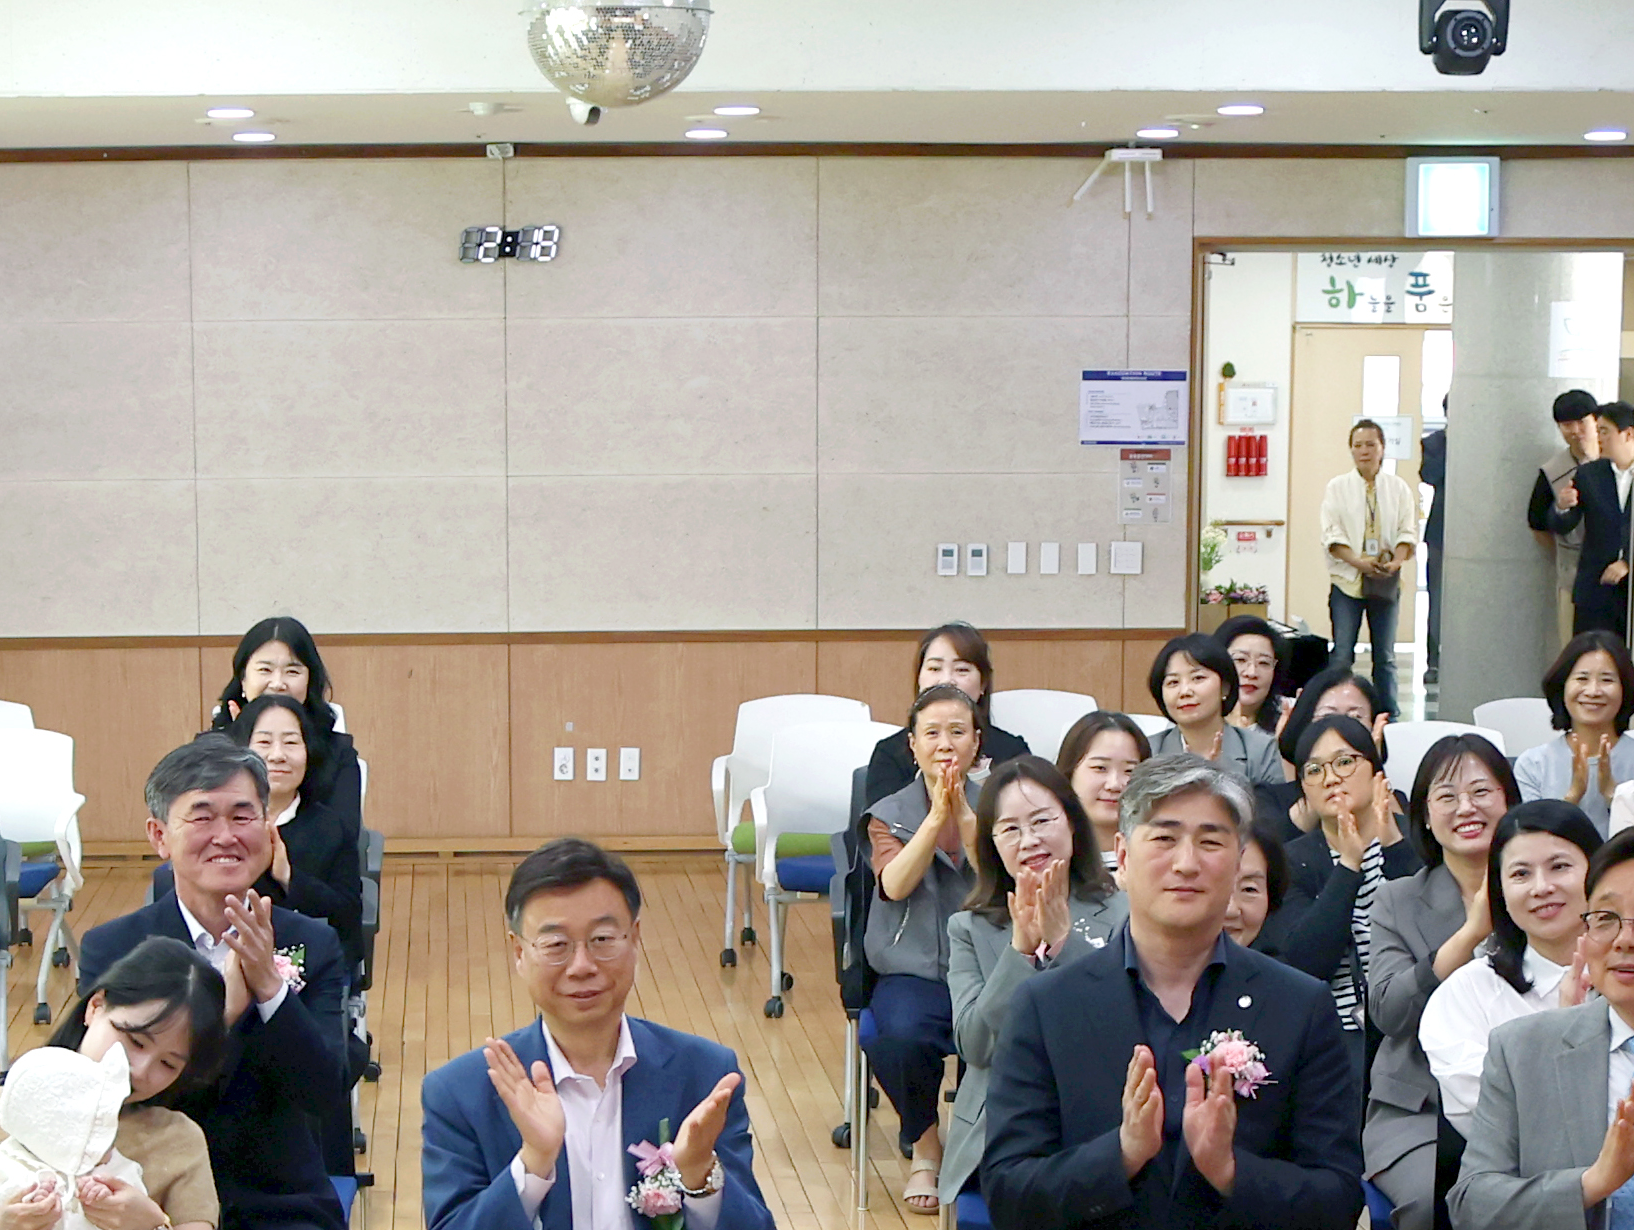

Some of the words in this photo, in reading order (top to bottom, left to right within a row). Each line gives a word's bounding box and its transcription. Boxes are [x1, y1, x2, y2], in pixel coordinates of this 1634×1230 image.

[1320, 252, 1362, 268] 청소년
[1367, 253, 1399, 268] 세상
[1322, 275, 1396, 313] 하늘을
[1405, 271, 1453, 313] 품은
